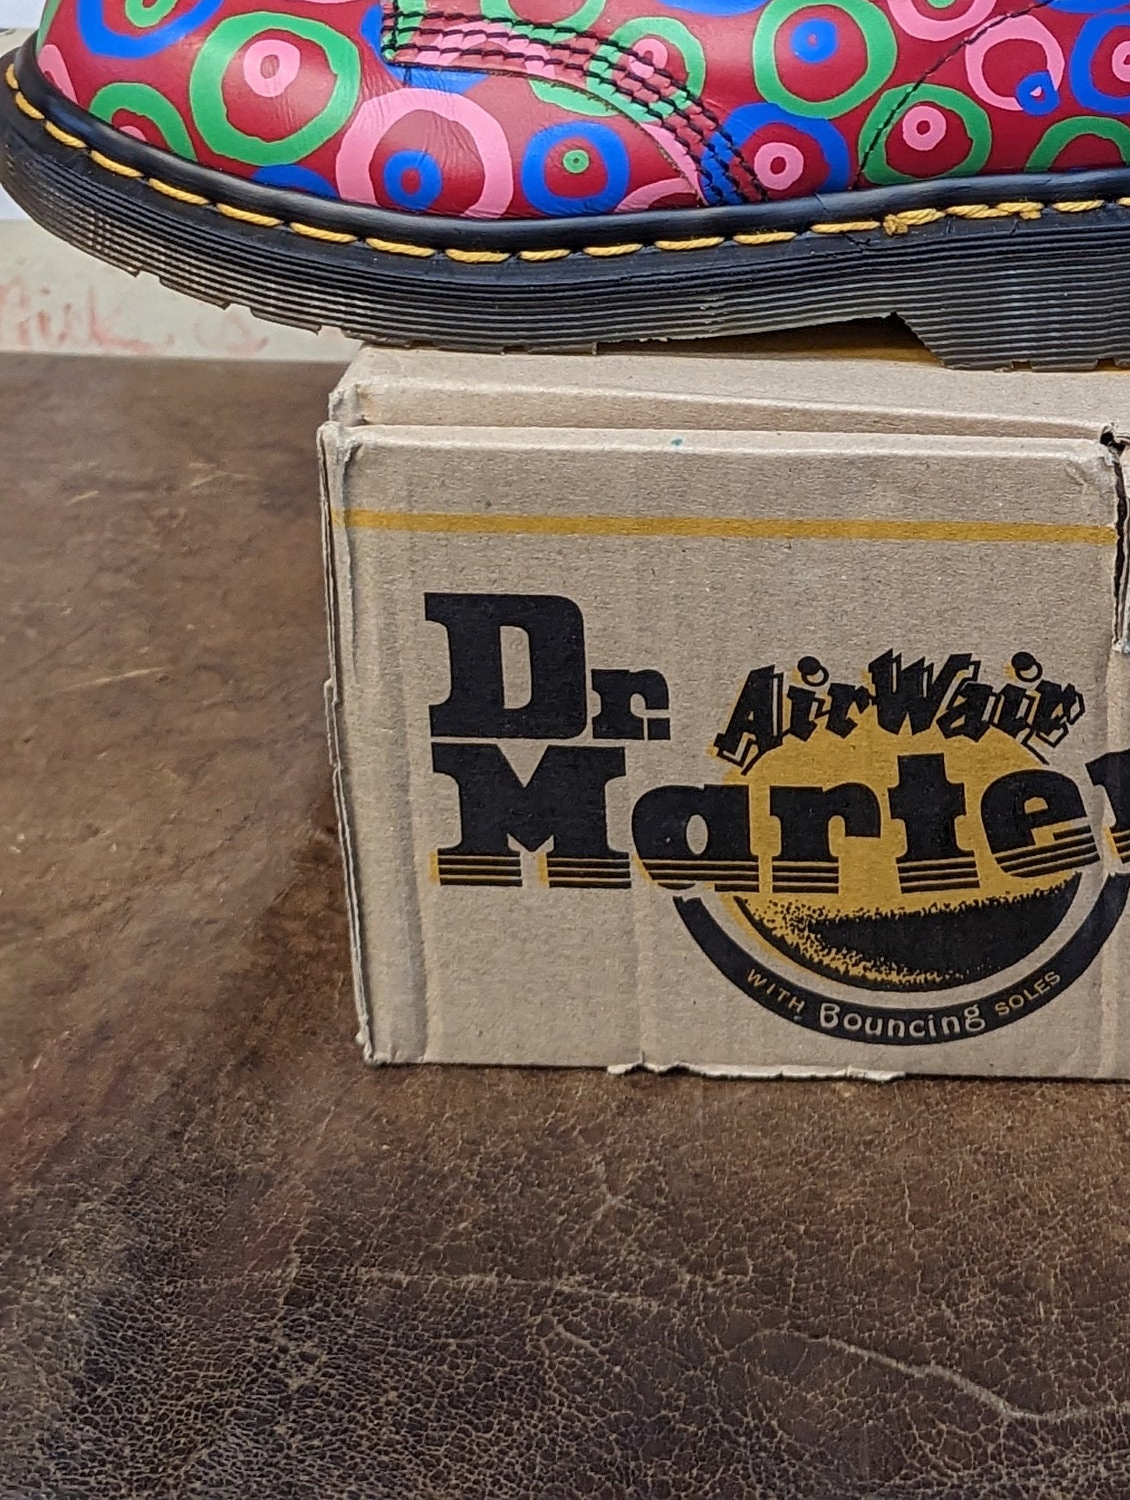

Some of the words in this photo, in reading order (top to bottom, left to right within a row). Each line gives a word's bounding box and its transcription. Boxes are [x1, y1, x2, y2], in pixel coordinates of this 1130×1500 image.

[424, 592, 671, 741] Dr.
[714, 649, 1086, 776] AirWair
[747, 968, 806, 1013] WITH
[818, 1002, 986, 1039] Bouncing
[994, 970, 1062, 1017] SOLES
